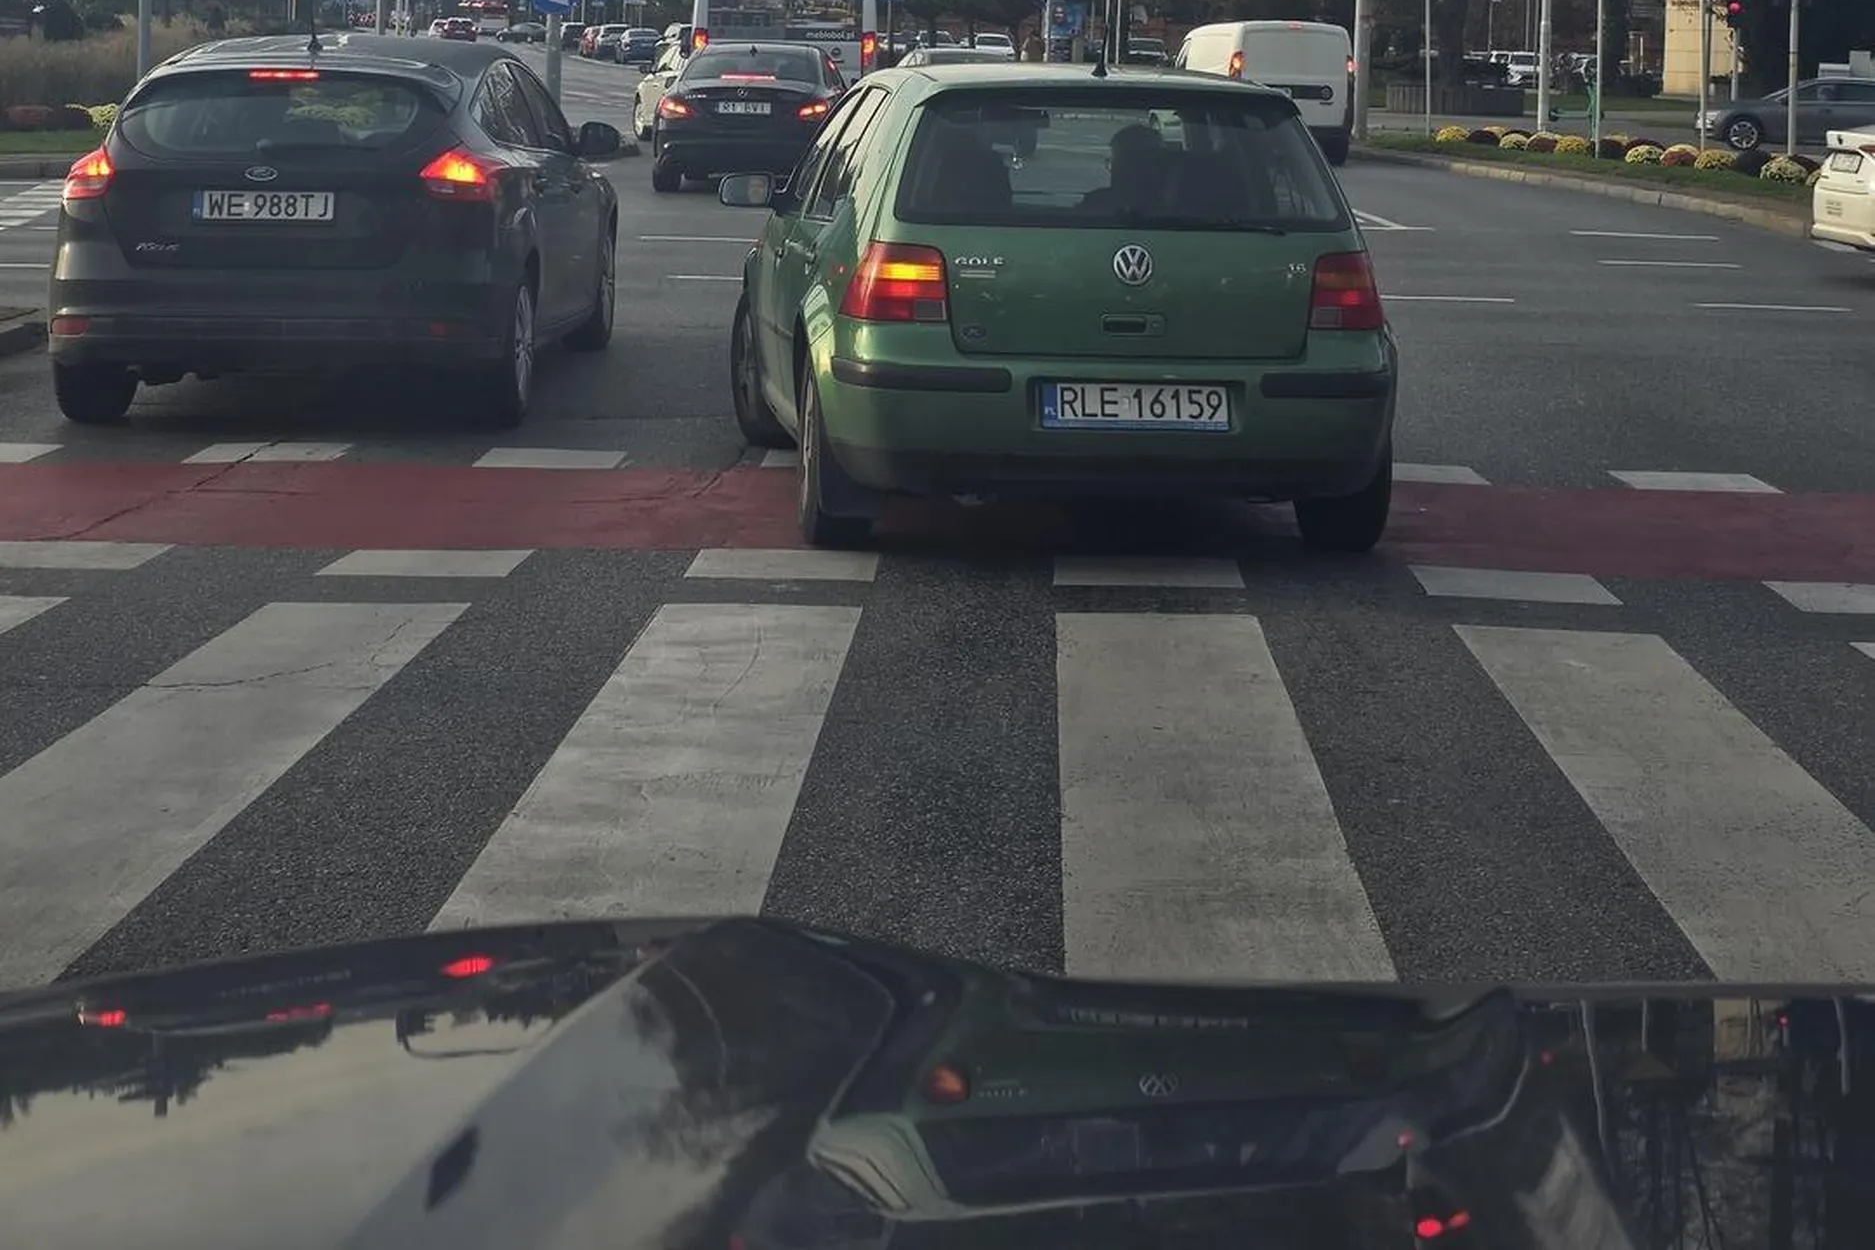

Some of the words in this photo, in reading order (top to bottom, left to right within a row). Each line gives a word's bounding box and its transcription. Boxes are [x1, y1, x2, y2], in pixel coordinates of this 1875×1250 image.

[208, 193, 245, 217] WE
[253, 194, 329, 218] 988TJ
[1060, 387, 1119, 418] RLE
[1132, 388, 1223, 420] 16159
